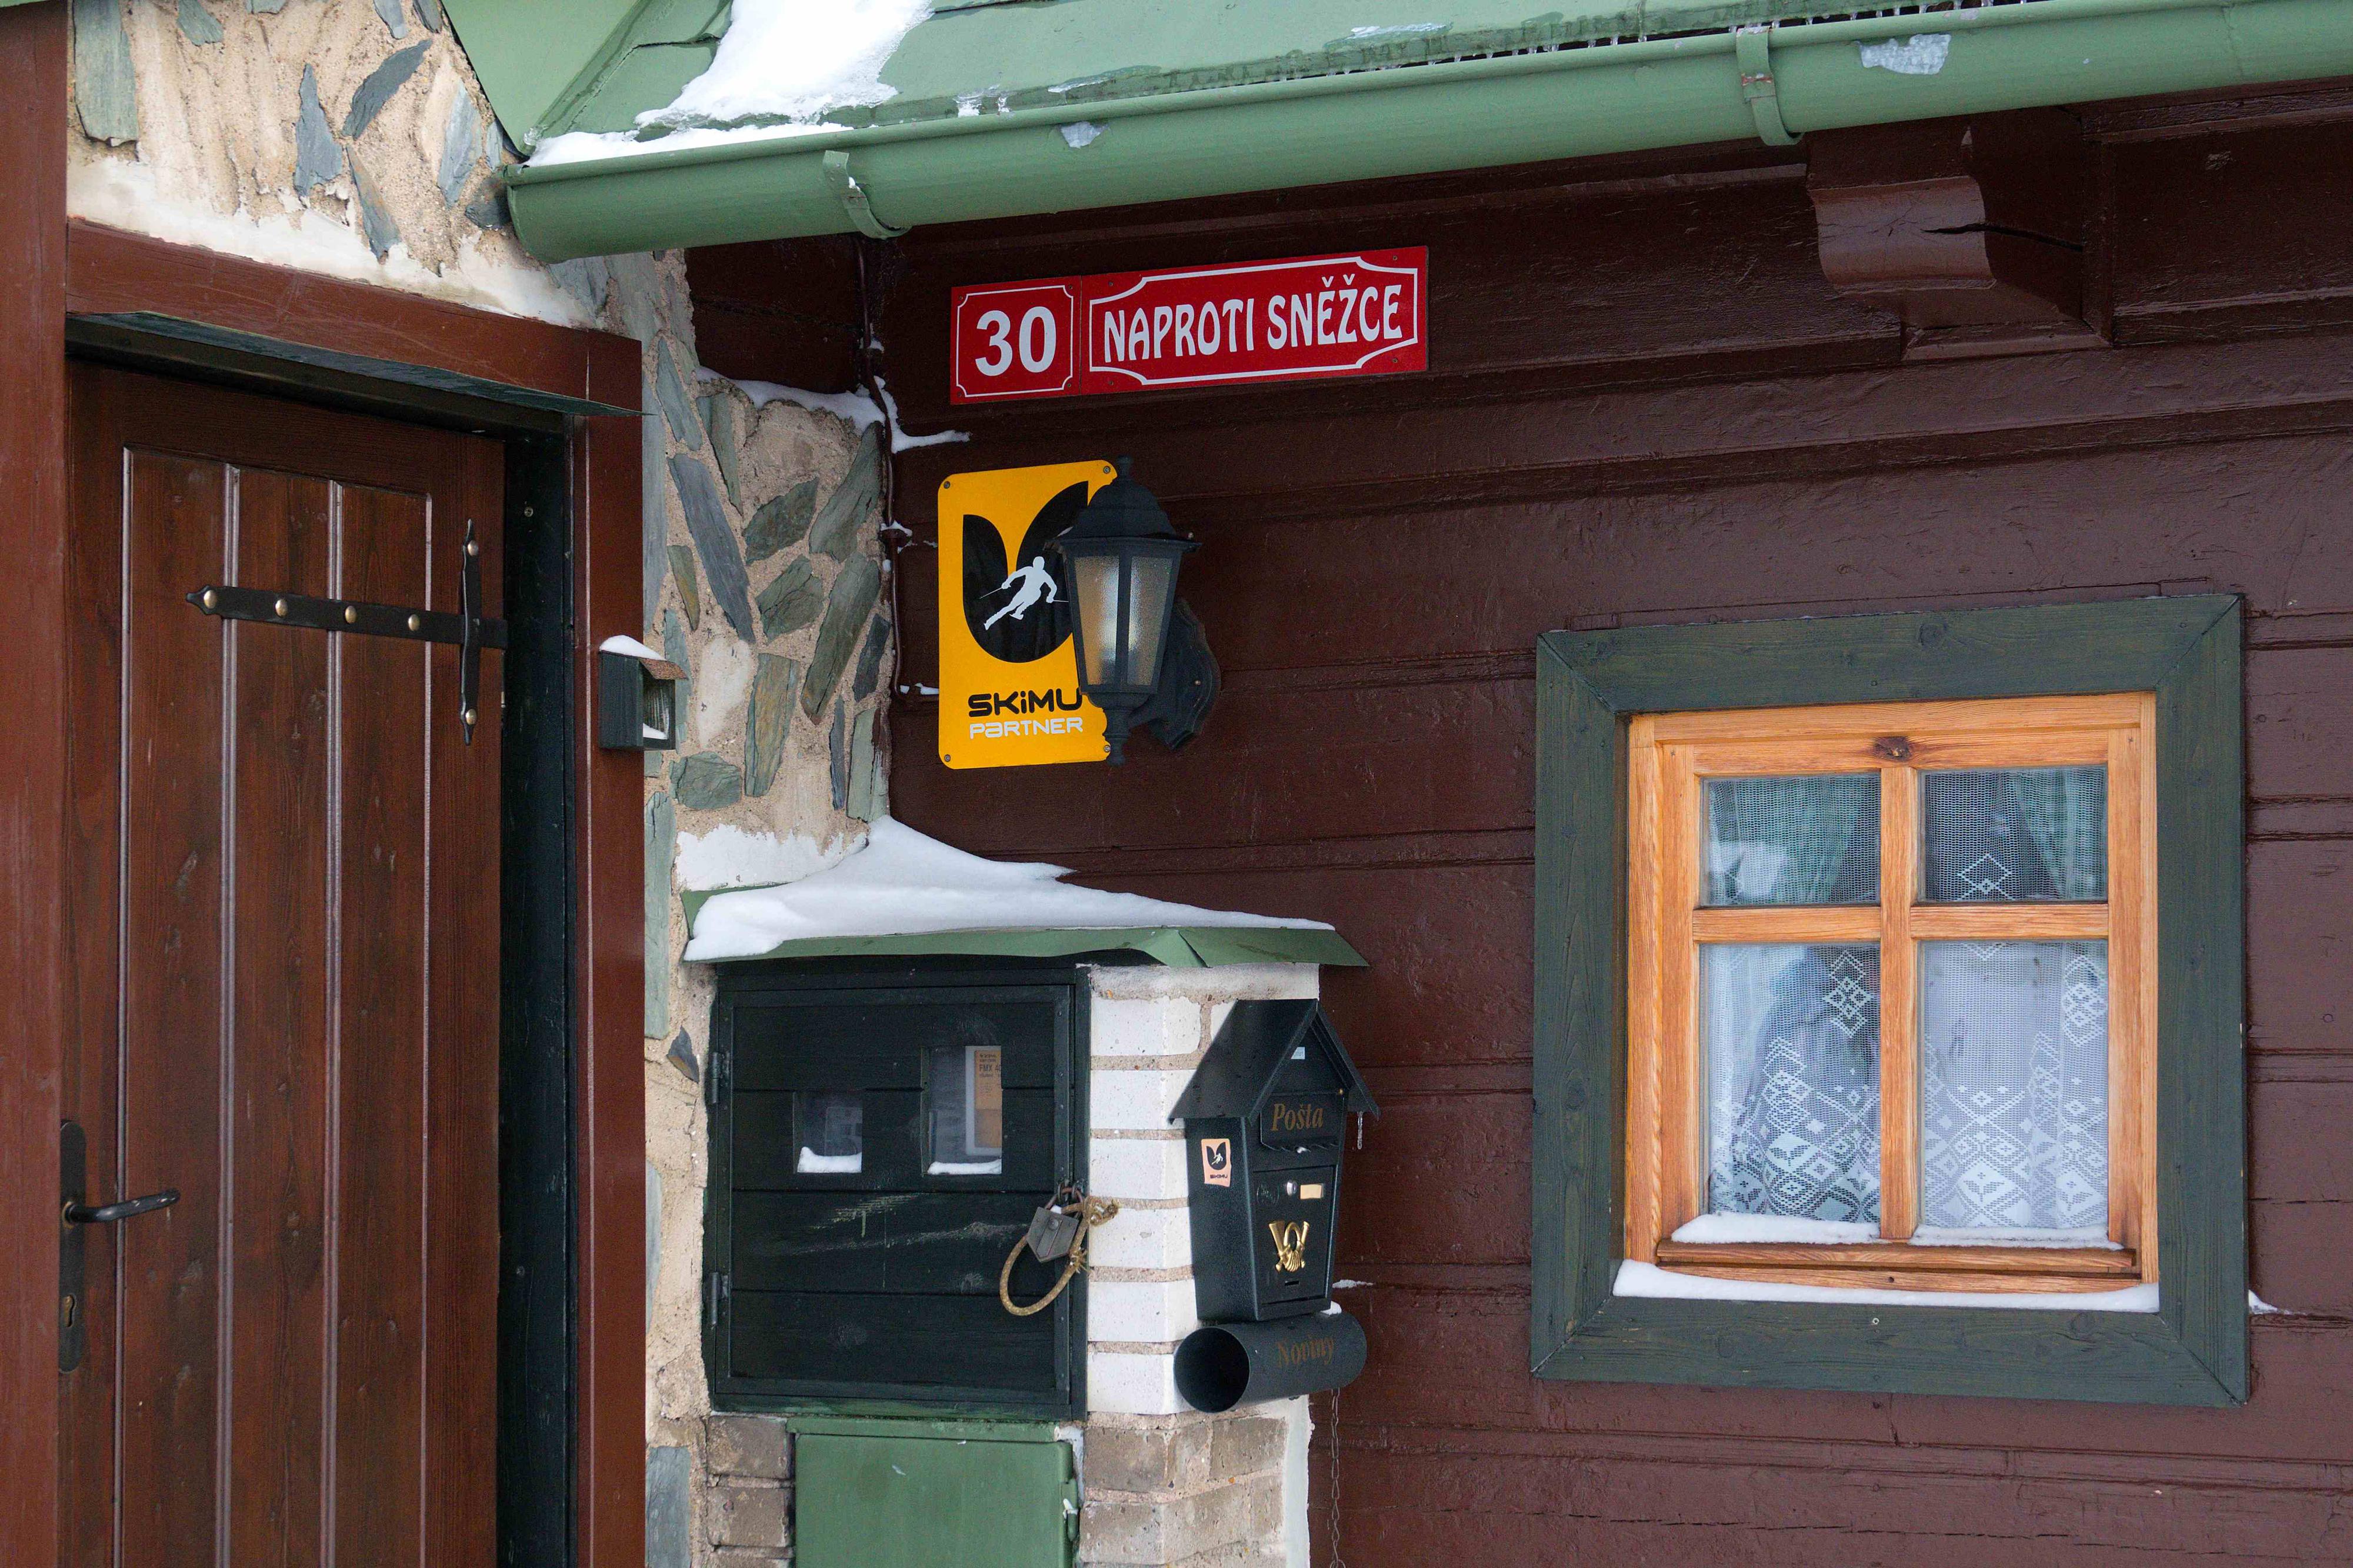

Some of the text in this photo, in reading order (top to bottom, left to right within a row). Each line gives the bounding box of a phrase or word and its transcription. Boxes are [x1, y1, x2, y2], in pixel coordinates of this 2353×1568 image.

[974, 305, 1056, 377] 30
[1104, 273, 1403, 363] NAPROTI SNĚŽCE
